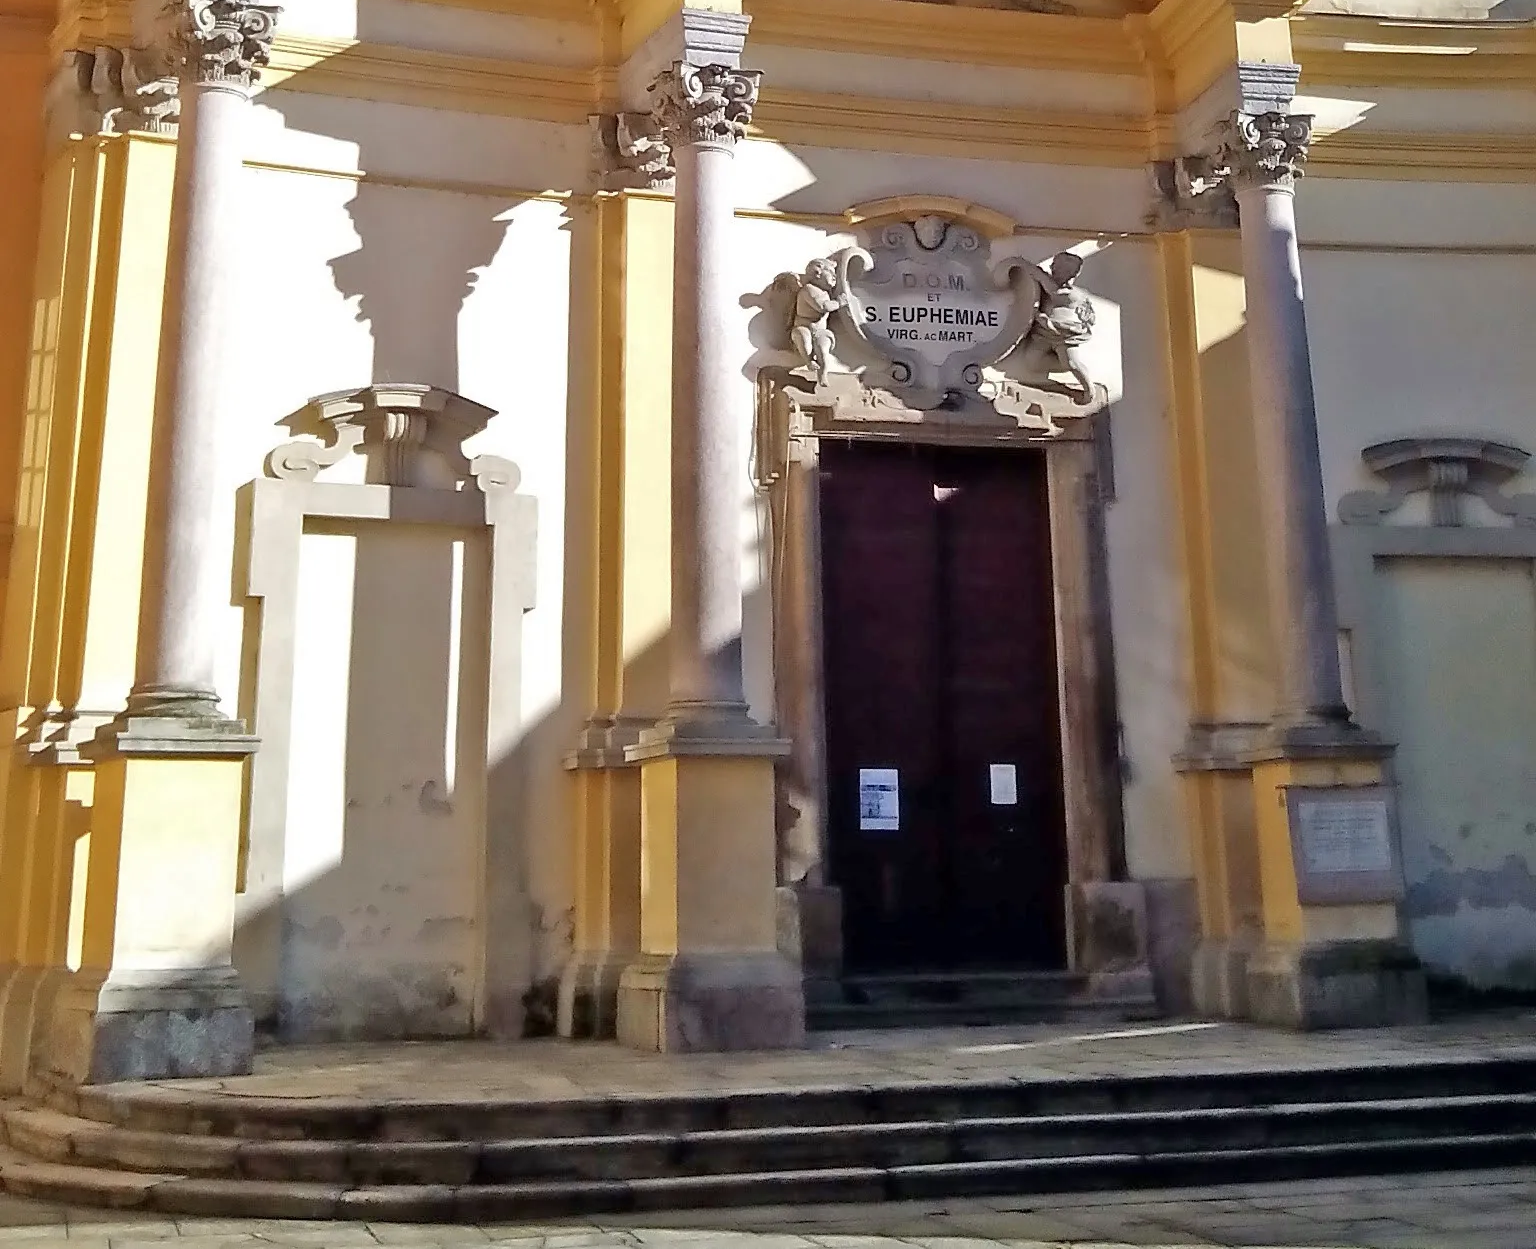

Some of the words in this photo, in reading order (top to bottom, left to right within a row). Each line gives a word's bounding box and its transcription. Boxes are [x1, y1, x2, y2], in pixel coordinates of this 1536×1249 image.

[927, 293, 942, 302] ET
[865, 306, 882, 322] S.
[889, 307, 999, 327] EUPHEMIAE
[887, 329, 922, 340] VIRG.
[938, 330, 977, 343] MART.
